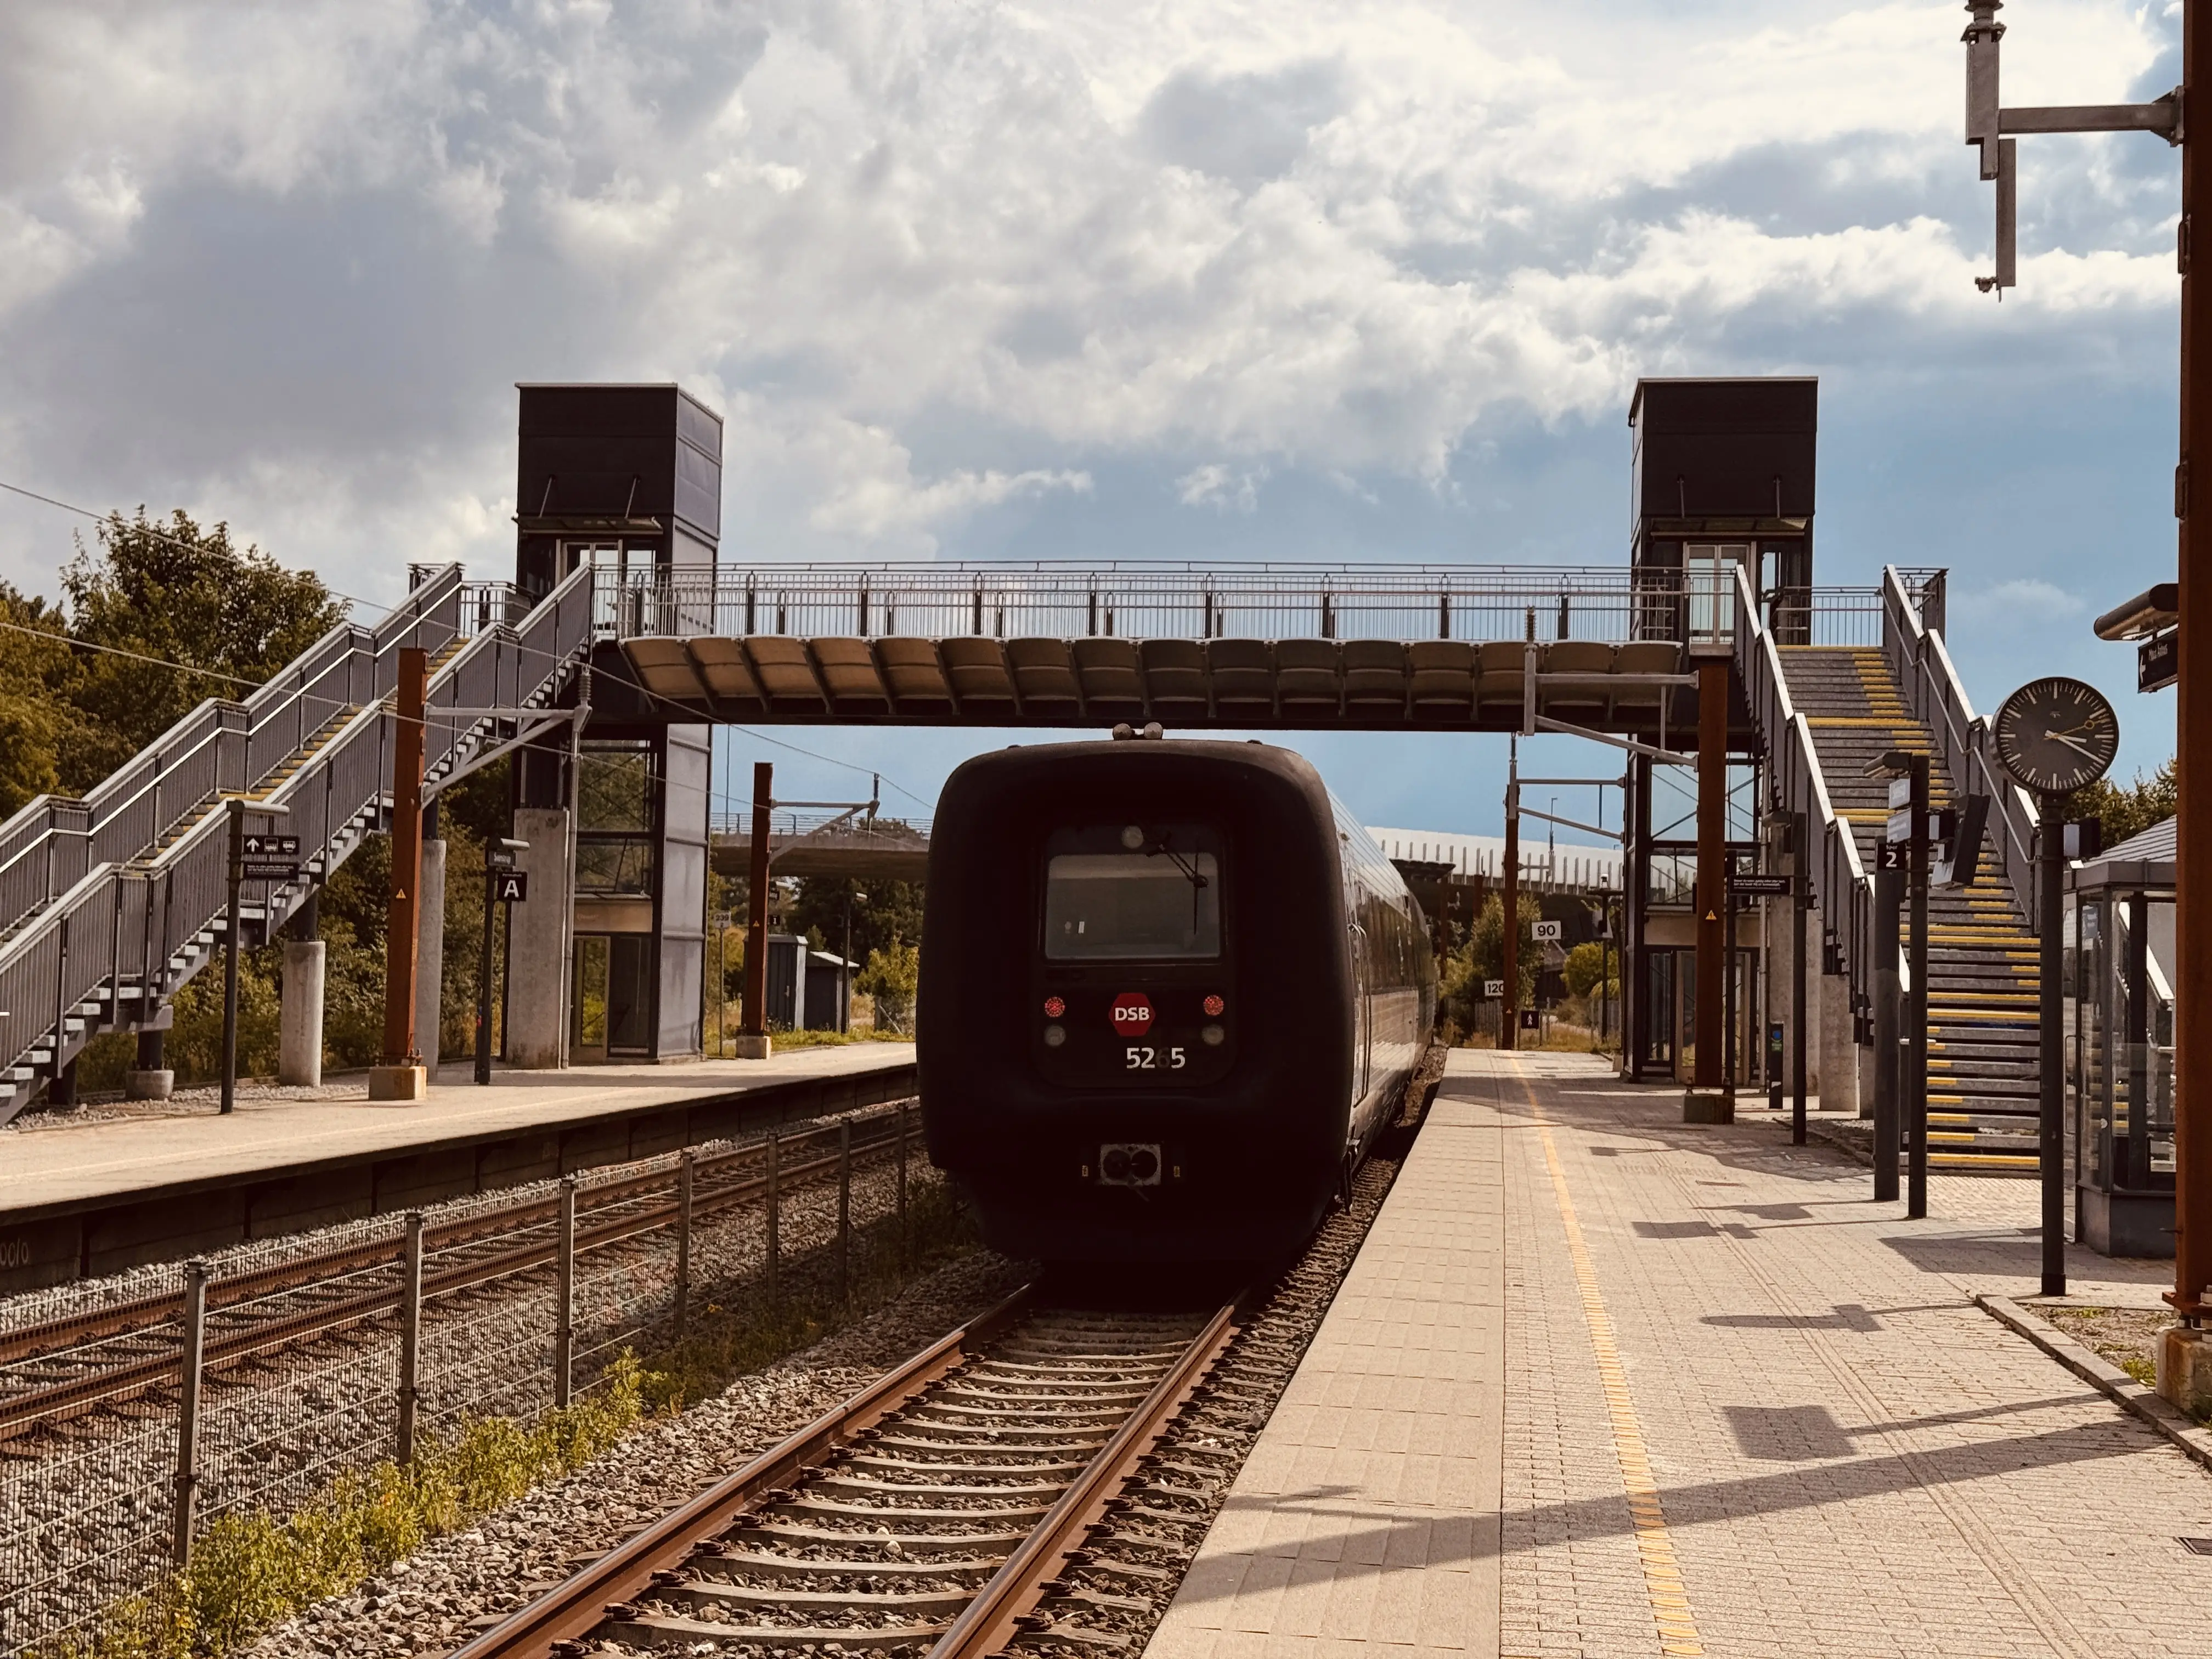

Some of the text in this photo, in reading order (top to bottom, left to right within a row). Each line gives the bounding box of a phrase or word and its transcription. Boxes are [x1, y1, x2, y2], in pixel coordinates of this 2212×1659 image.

[1886, 851, 1897, 867] 2
[504, 880, 519, 898] A
[1537, 925, 1556, 936] 90
[1115, 1007, 1150, 1021] DSB
